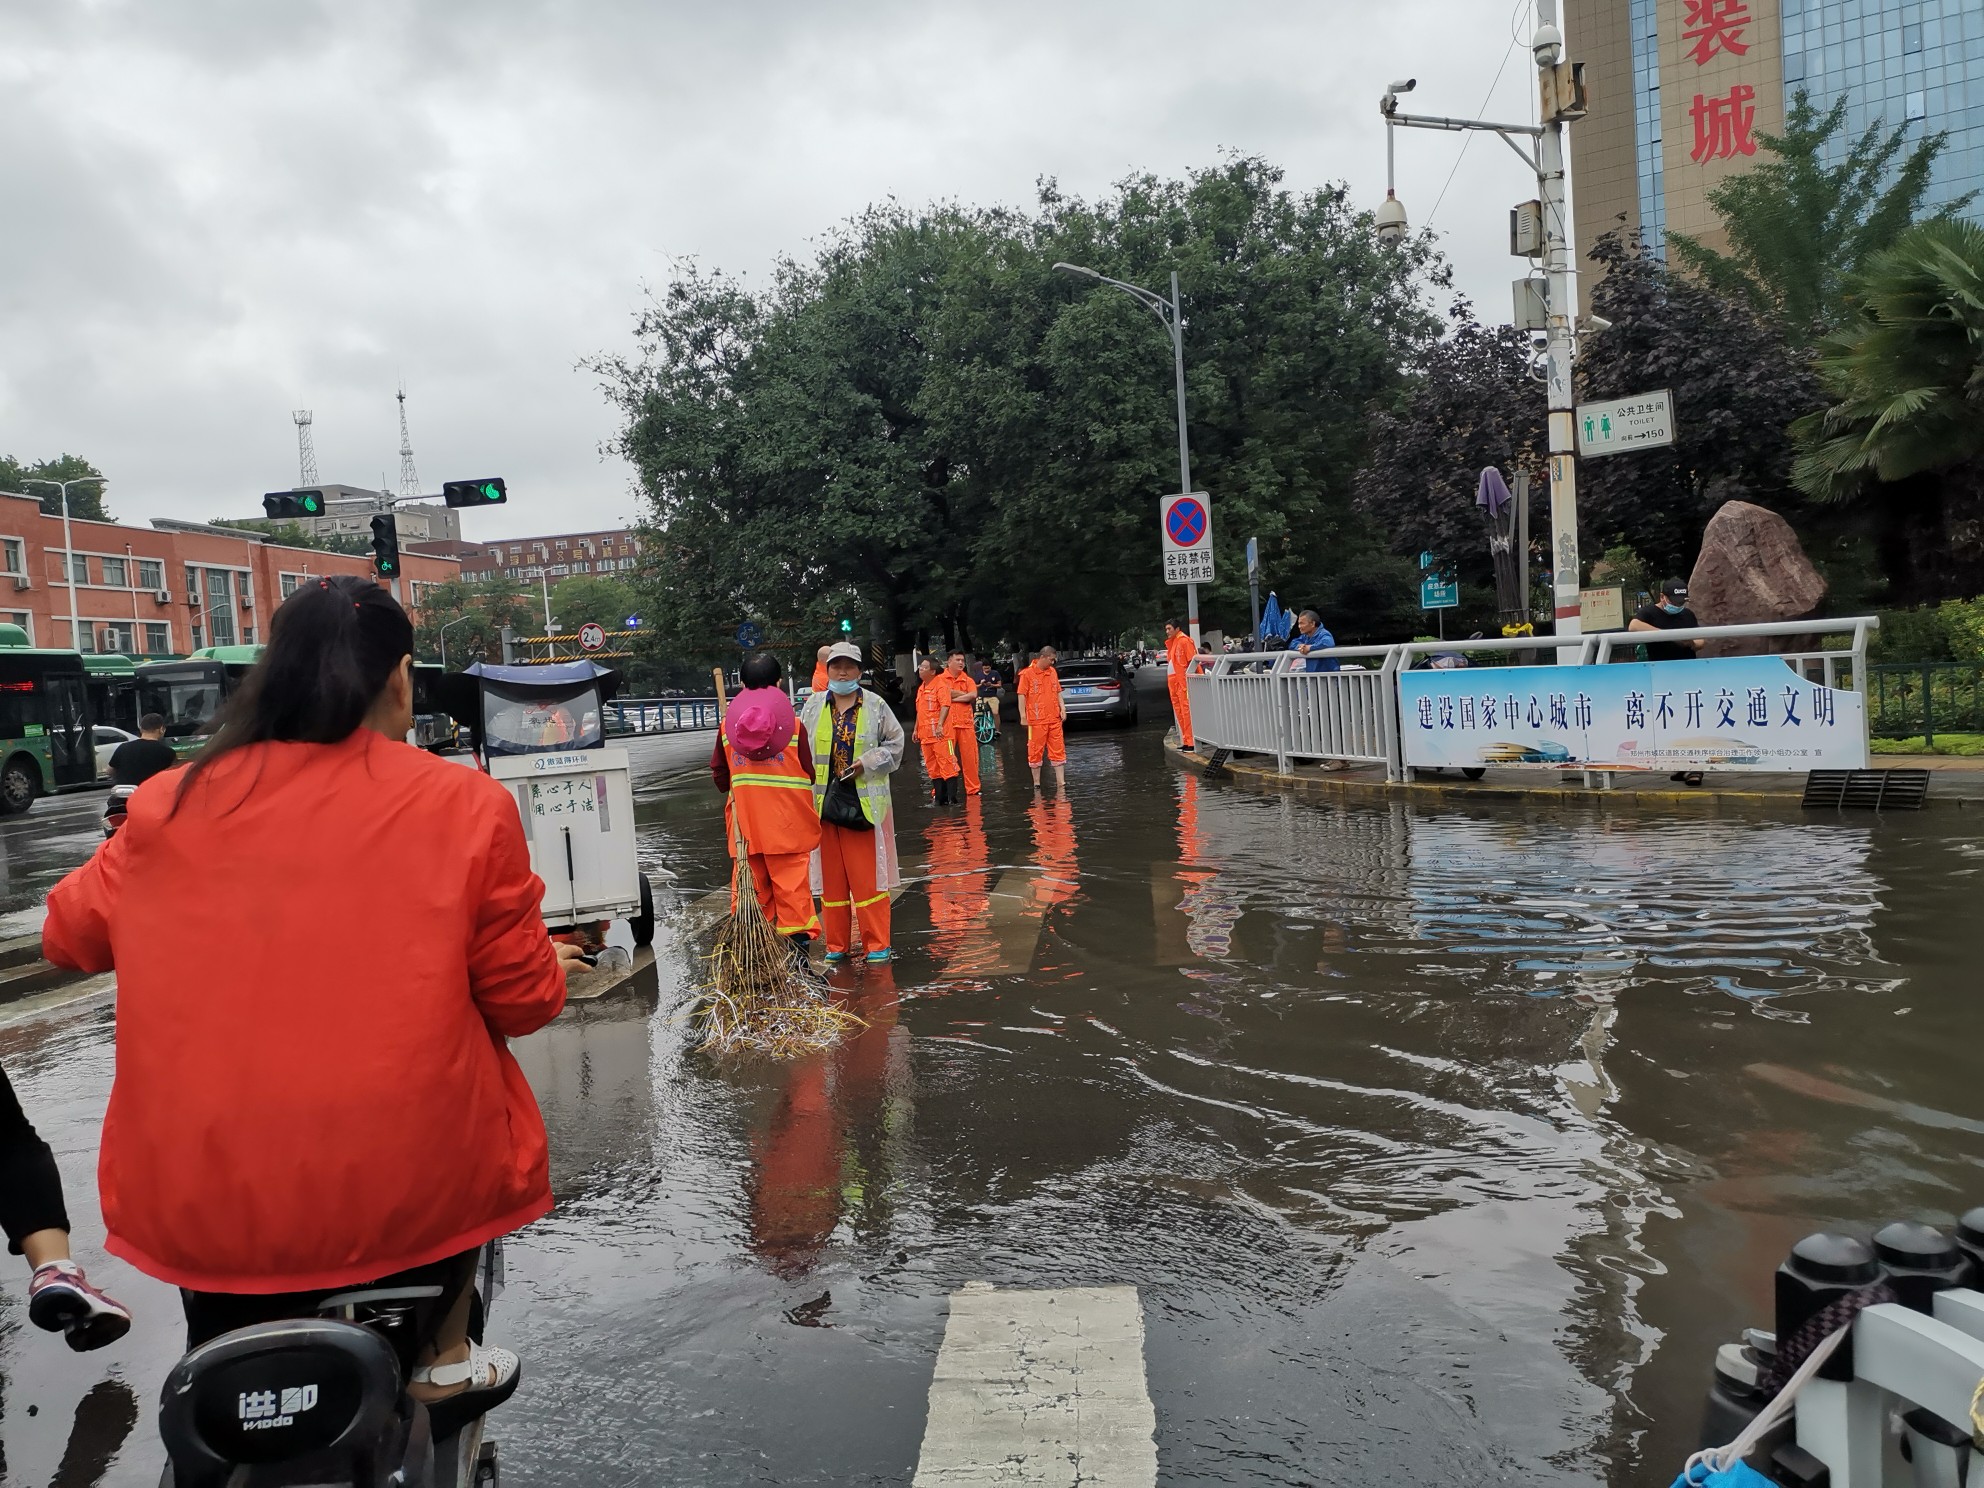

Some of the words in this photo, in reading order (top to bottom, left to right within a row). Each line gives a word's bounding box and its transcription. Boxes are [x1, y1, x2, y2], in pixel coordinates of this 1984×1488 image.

[1617, 402, 1664, 417] 公共卫生间
[1629, 417, 1655, 426] TOILET
[1645, 428, 1664, 439] 150
[1166, 551, 1211, 566] 全段禁停
[1167, 566, 1212, 580] 违停抓拍
[1417, 691, 1592, 731] 建设国家中心城市
[1625, 686, 1836, 730] 离不开交通文明
[1814, 748, 1823, 757] 宣
[534, 798, 594, 816] 用心于洁
